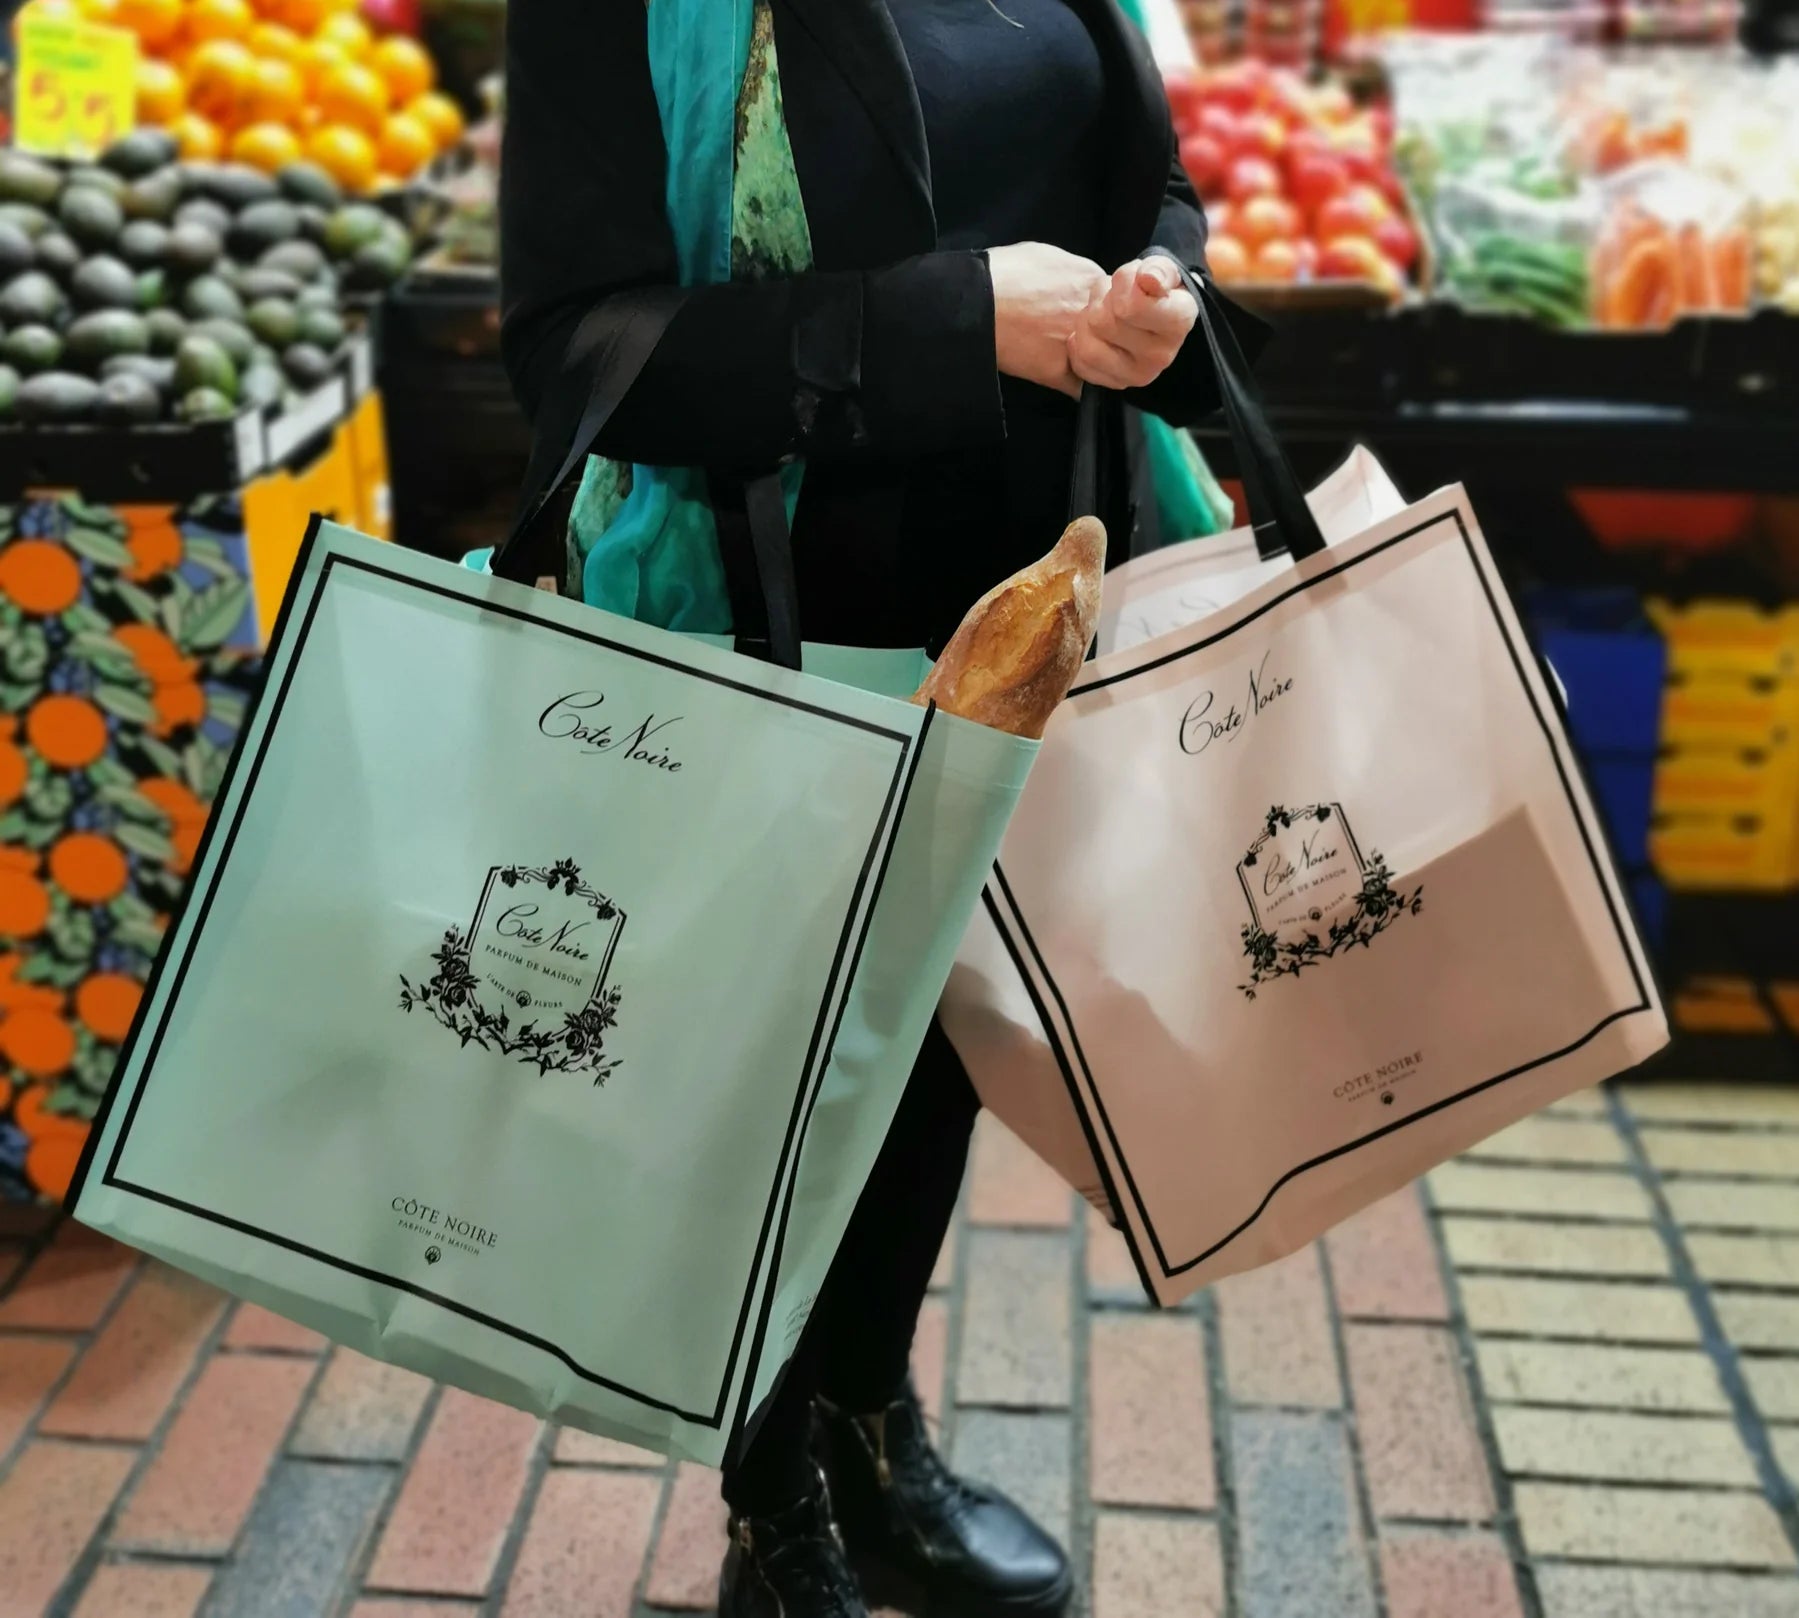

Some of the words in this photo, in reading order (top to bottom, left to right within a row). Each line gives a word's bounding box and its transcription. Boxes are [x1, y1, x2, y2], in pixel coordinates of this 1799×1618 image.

[1178, 690, 1242, 755] Côte
[1228, 649, 1293, 743] Noire
[538, 690, 612, 748] Côte
[580, 713, 685, 773] Noire
[521, 920, 591, 961] Noire
[485, 944, 523, 965] PARFUM
[526, 960, 540, 971] DE
[542, 966, 582, 987] MAISON
[1376, 1050, 1423, 1077] NOIRE
[391, 1196, 440, 1224] CÔTE
[444, 1215, 498, 1248] NOIRE
[398, 1219, 432, 1236] PARFUM
[434, 1232, 446, 1242] DE
[447, 1238, 480, 1256] MAISON
